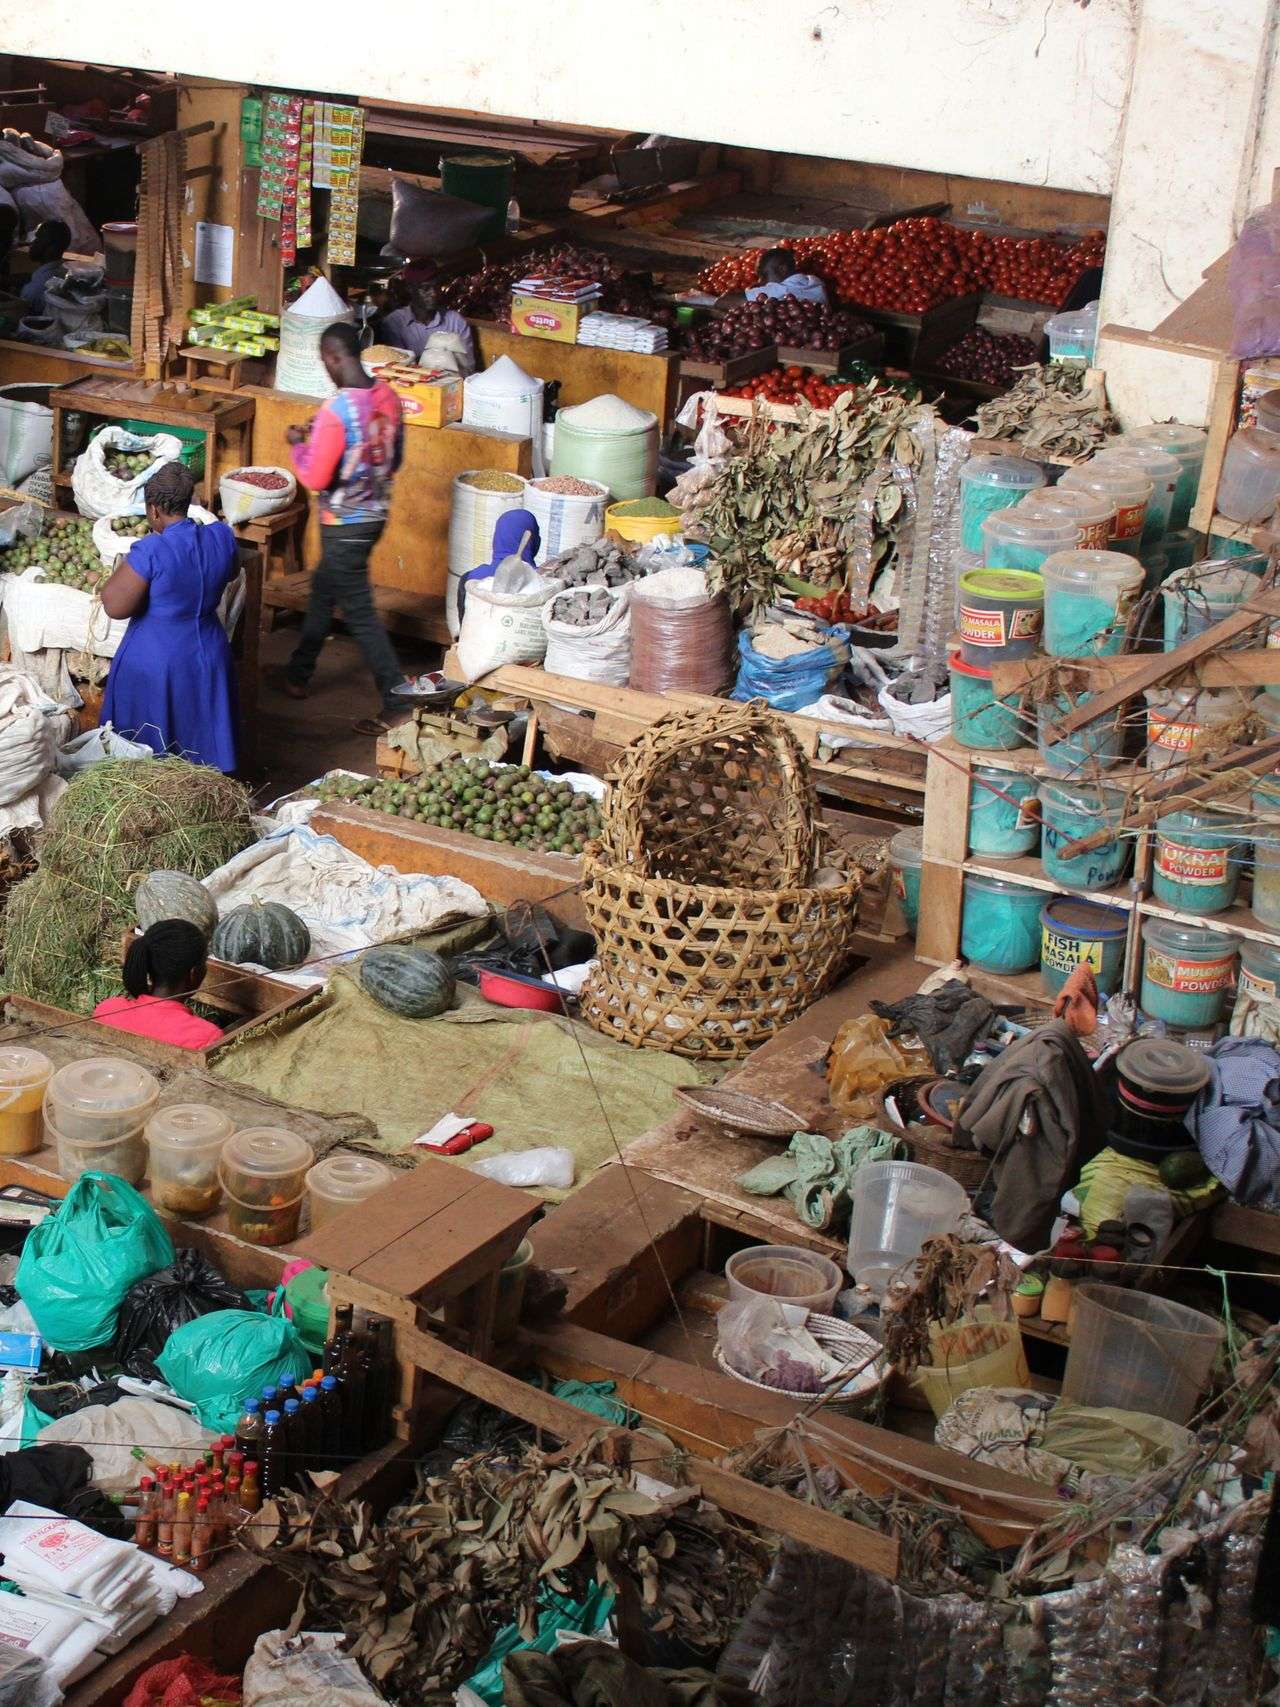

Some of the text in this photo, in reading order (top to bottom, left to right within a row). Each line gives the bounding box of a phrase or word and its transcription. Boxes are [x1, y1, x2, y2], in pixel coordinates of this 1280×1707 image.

[528, 315, 556, 327] Butto
[1160, 735, 1186, 748] SEED
[1164, 846, 1220, 867] OKRA
[1168, 862, 1217, 877] POWDER
[1048, 933, 1080, 953] FISH
[1043, 943, 1095, 965] MASALA
